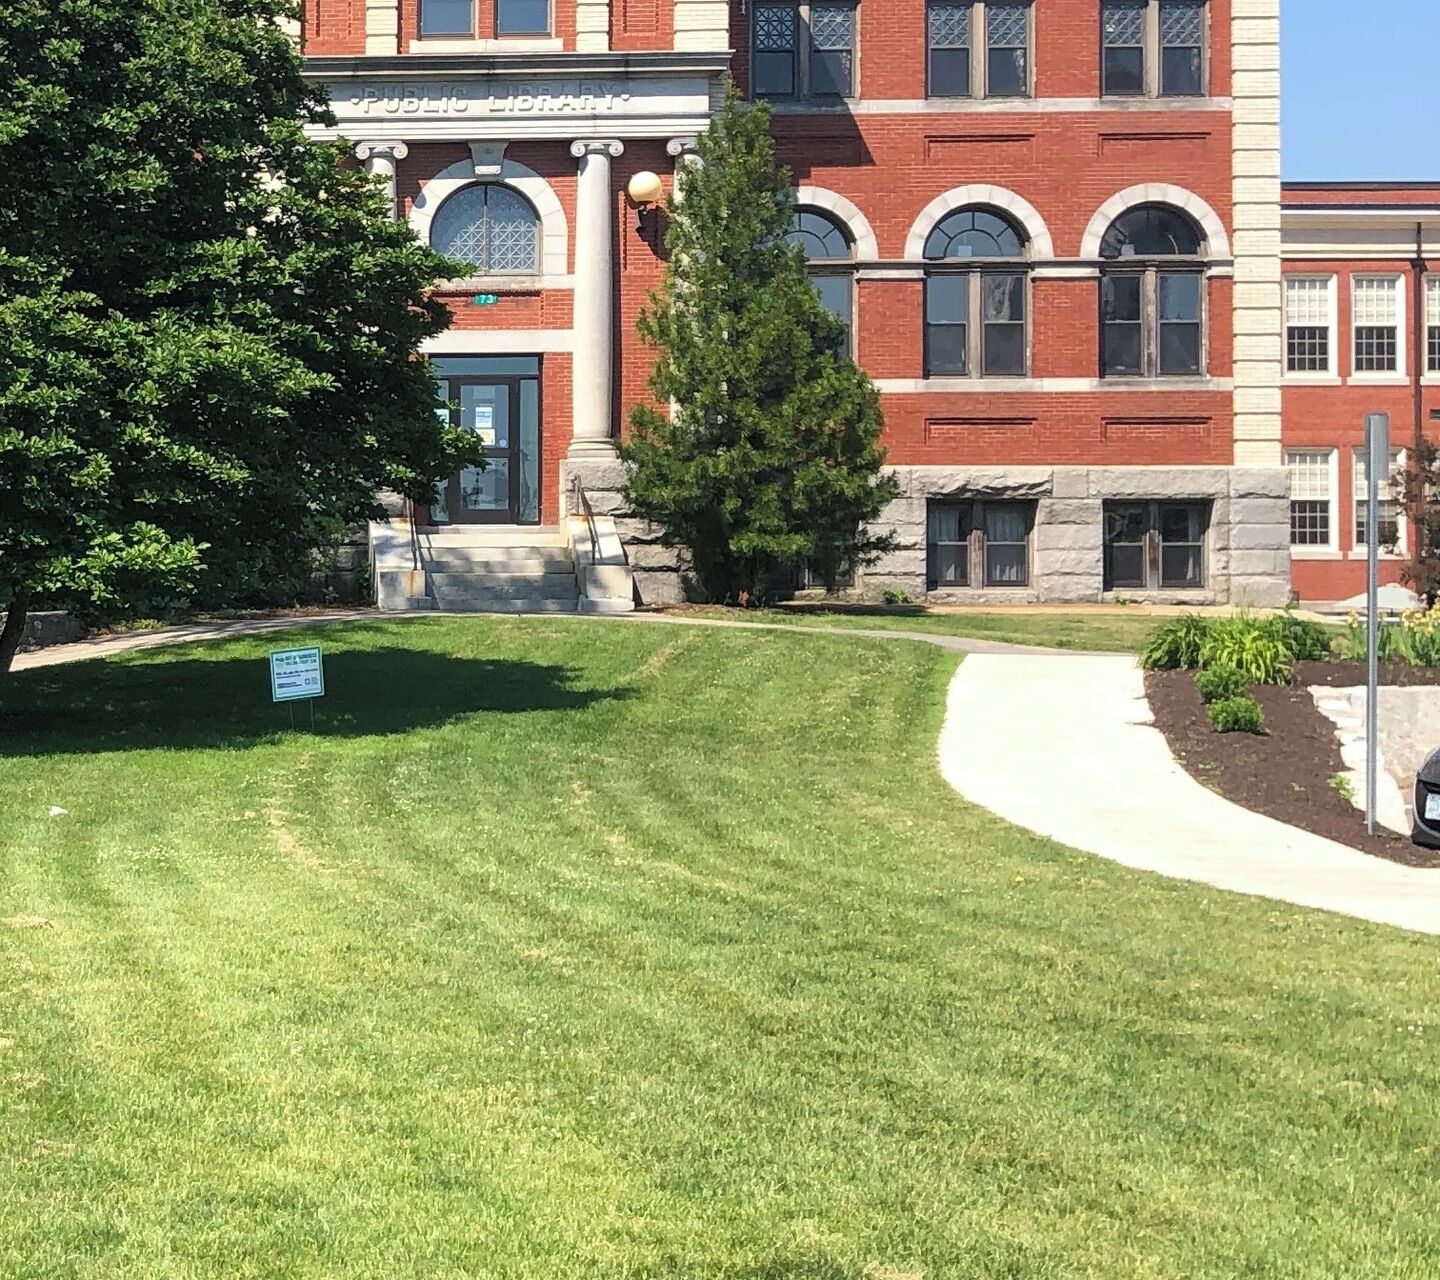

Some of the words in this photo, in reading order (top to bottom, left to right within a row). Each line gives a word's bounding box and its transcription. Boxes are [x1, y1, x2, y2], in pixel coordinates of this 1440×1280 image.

[362, 85, 469, 114] PUBLIC
[487, 82, 616, 113] LIBRARY
[479, 294, 494, 304] 73
